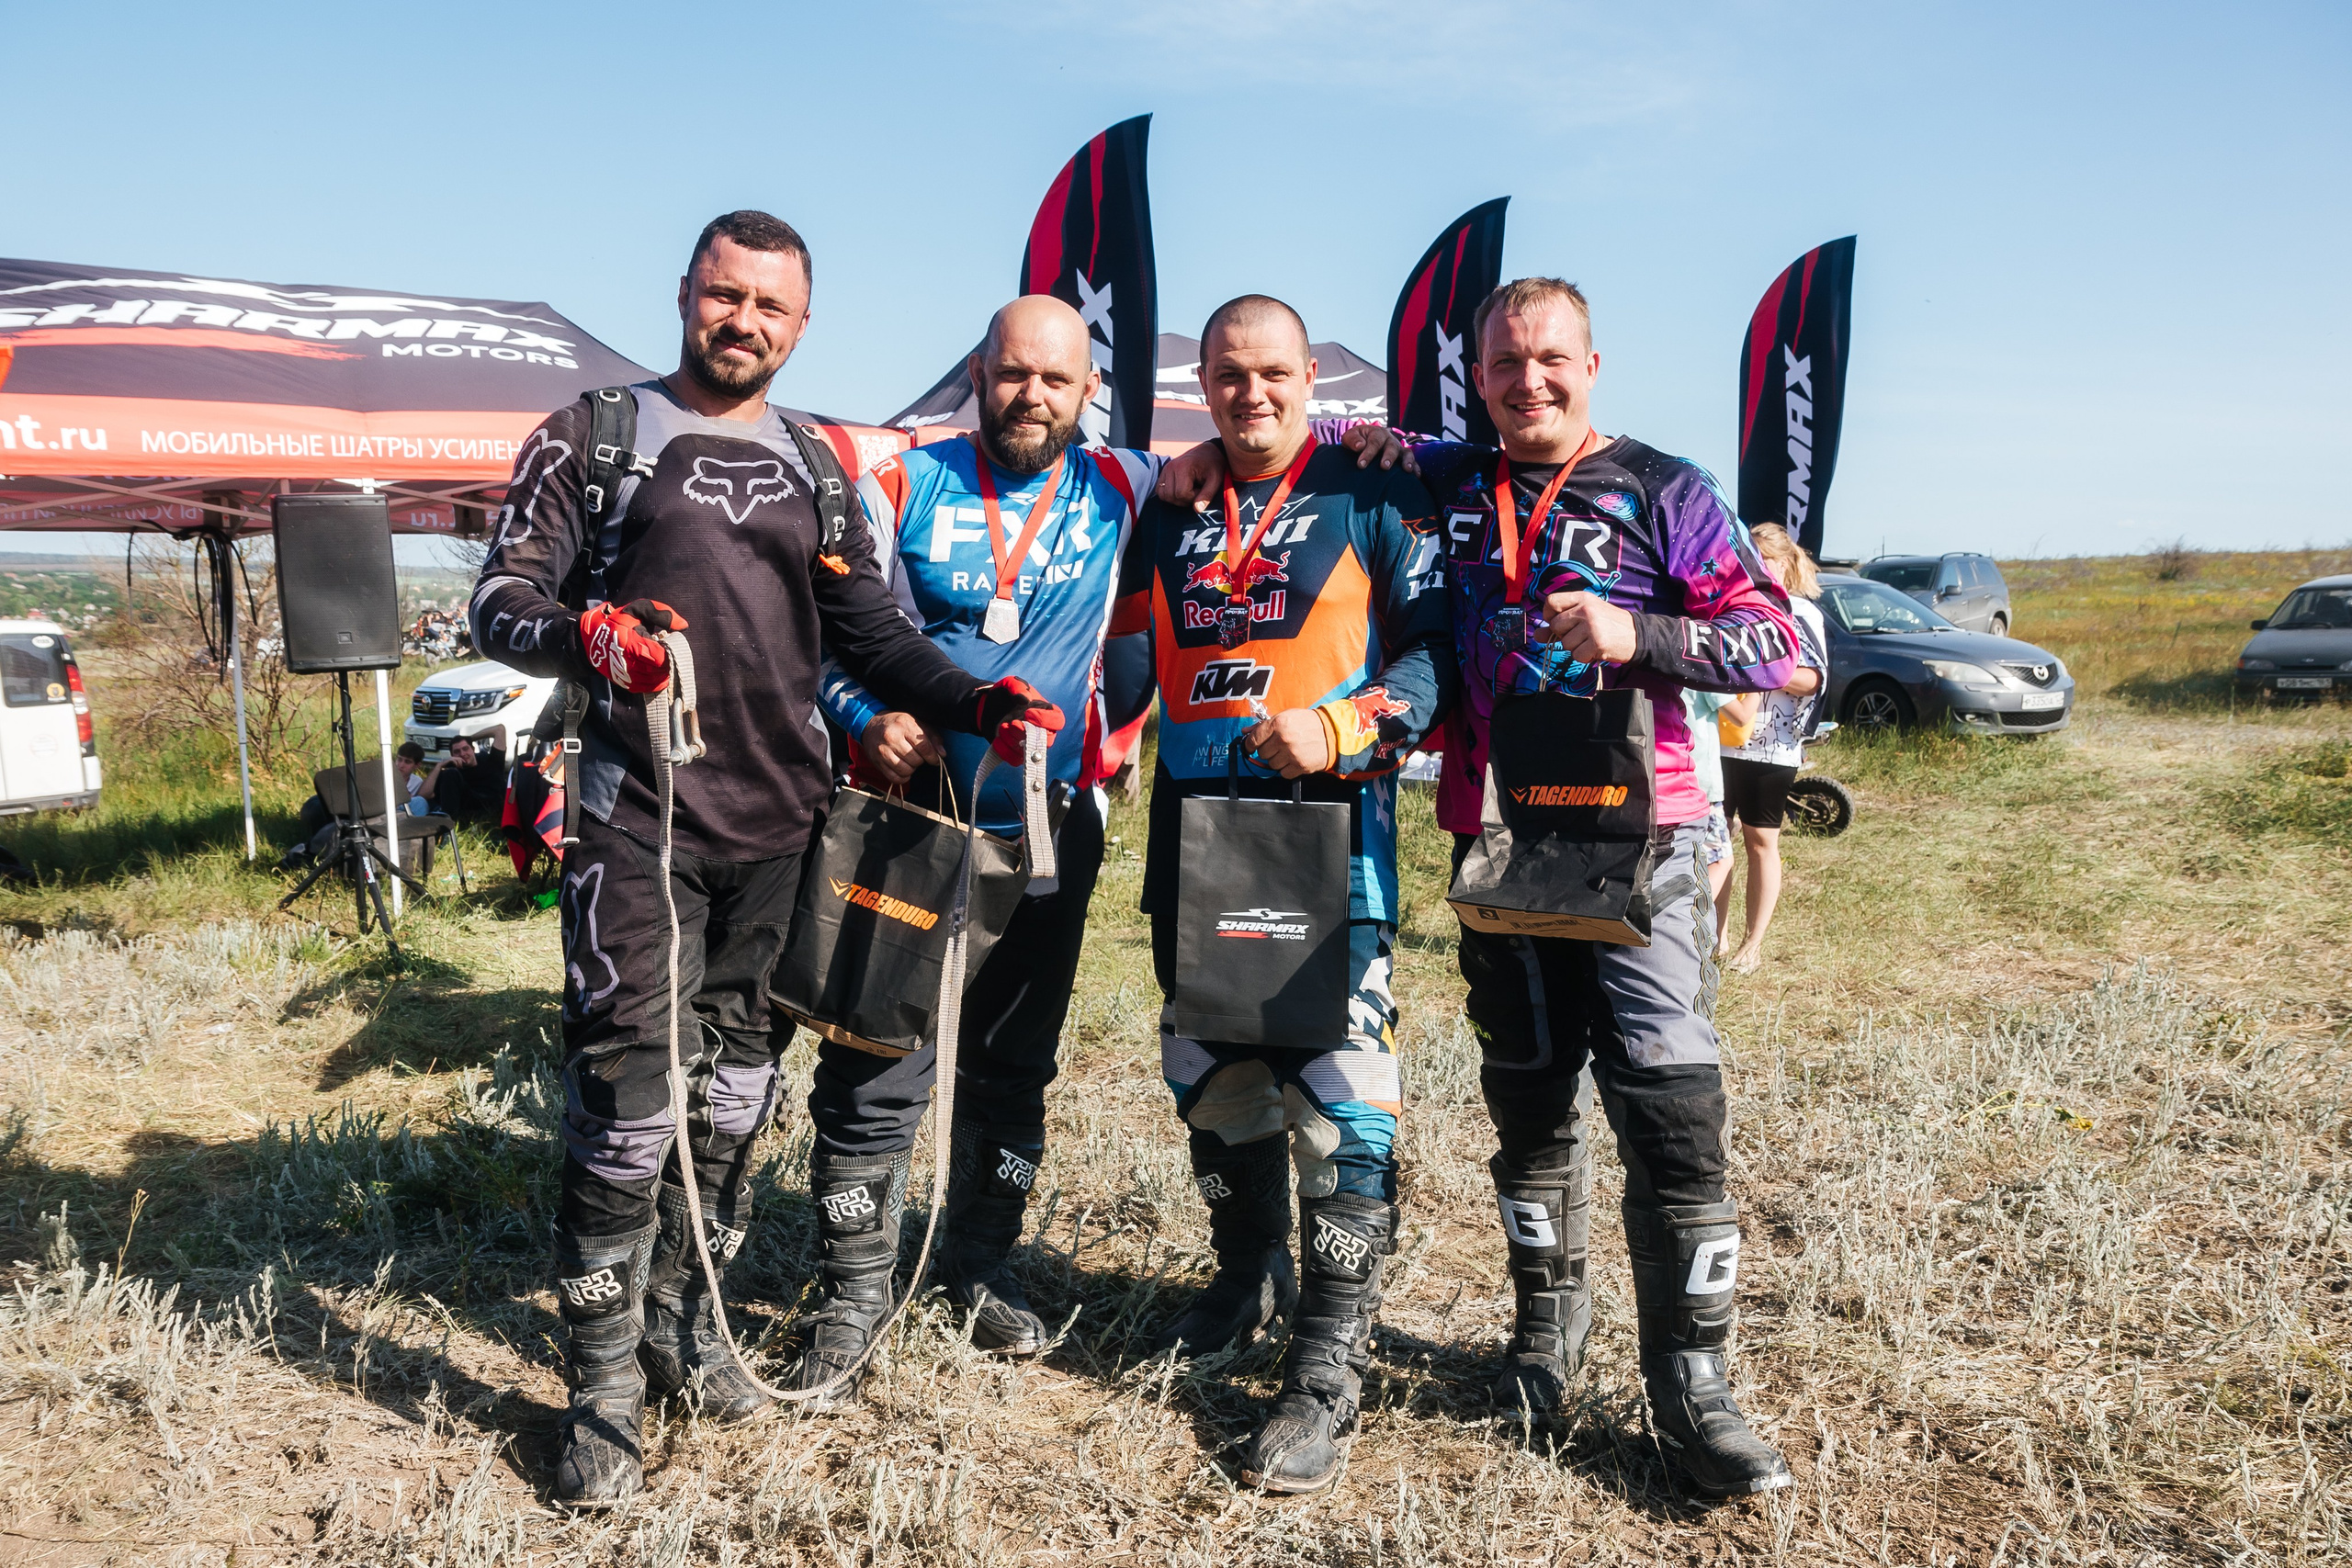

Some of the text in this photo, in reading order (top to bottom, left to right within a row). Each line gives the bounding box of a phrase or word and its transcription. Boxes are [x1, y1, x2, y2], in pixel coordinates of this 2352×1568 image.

[381, 342, 580, 369] MOTORS
[141, 429, 324, 457] МОБИЛЬНЫЕ
[330, 434, 424, 458] ШАТРЫ
[1688, 620, 1787, 663] FXR
[1189, 659, 1274, 705] KTM
[1526, 784, 1629, 807] TAGENDURO
[843, 883, 939, 931] TAGENDURO
[1216, 919, 1310, 933] SHARMAX
